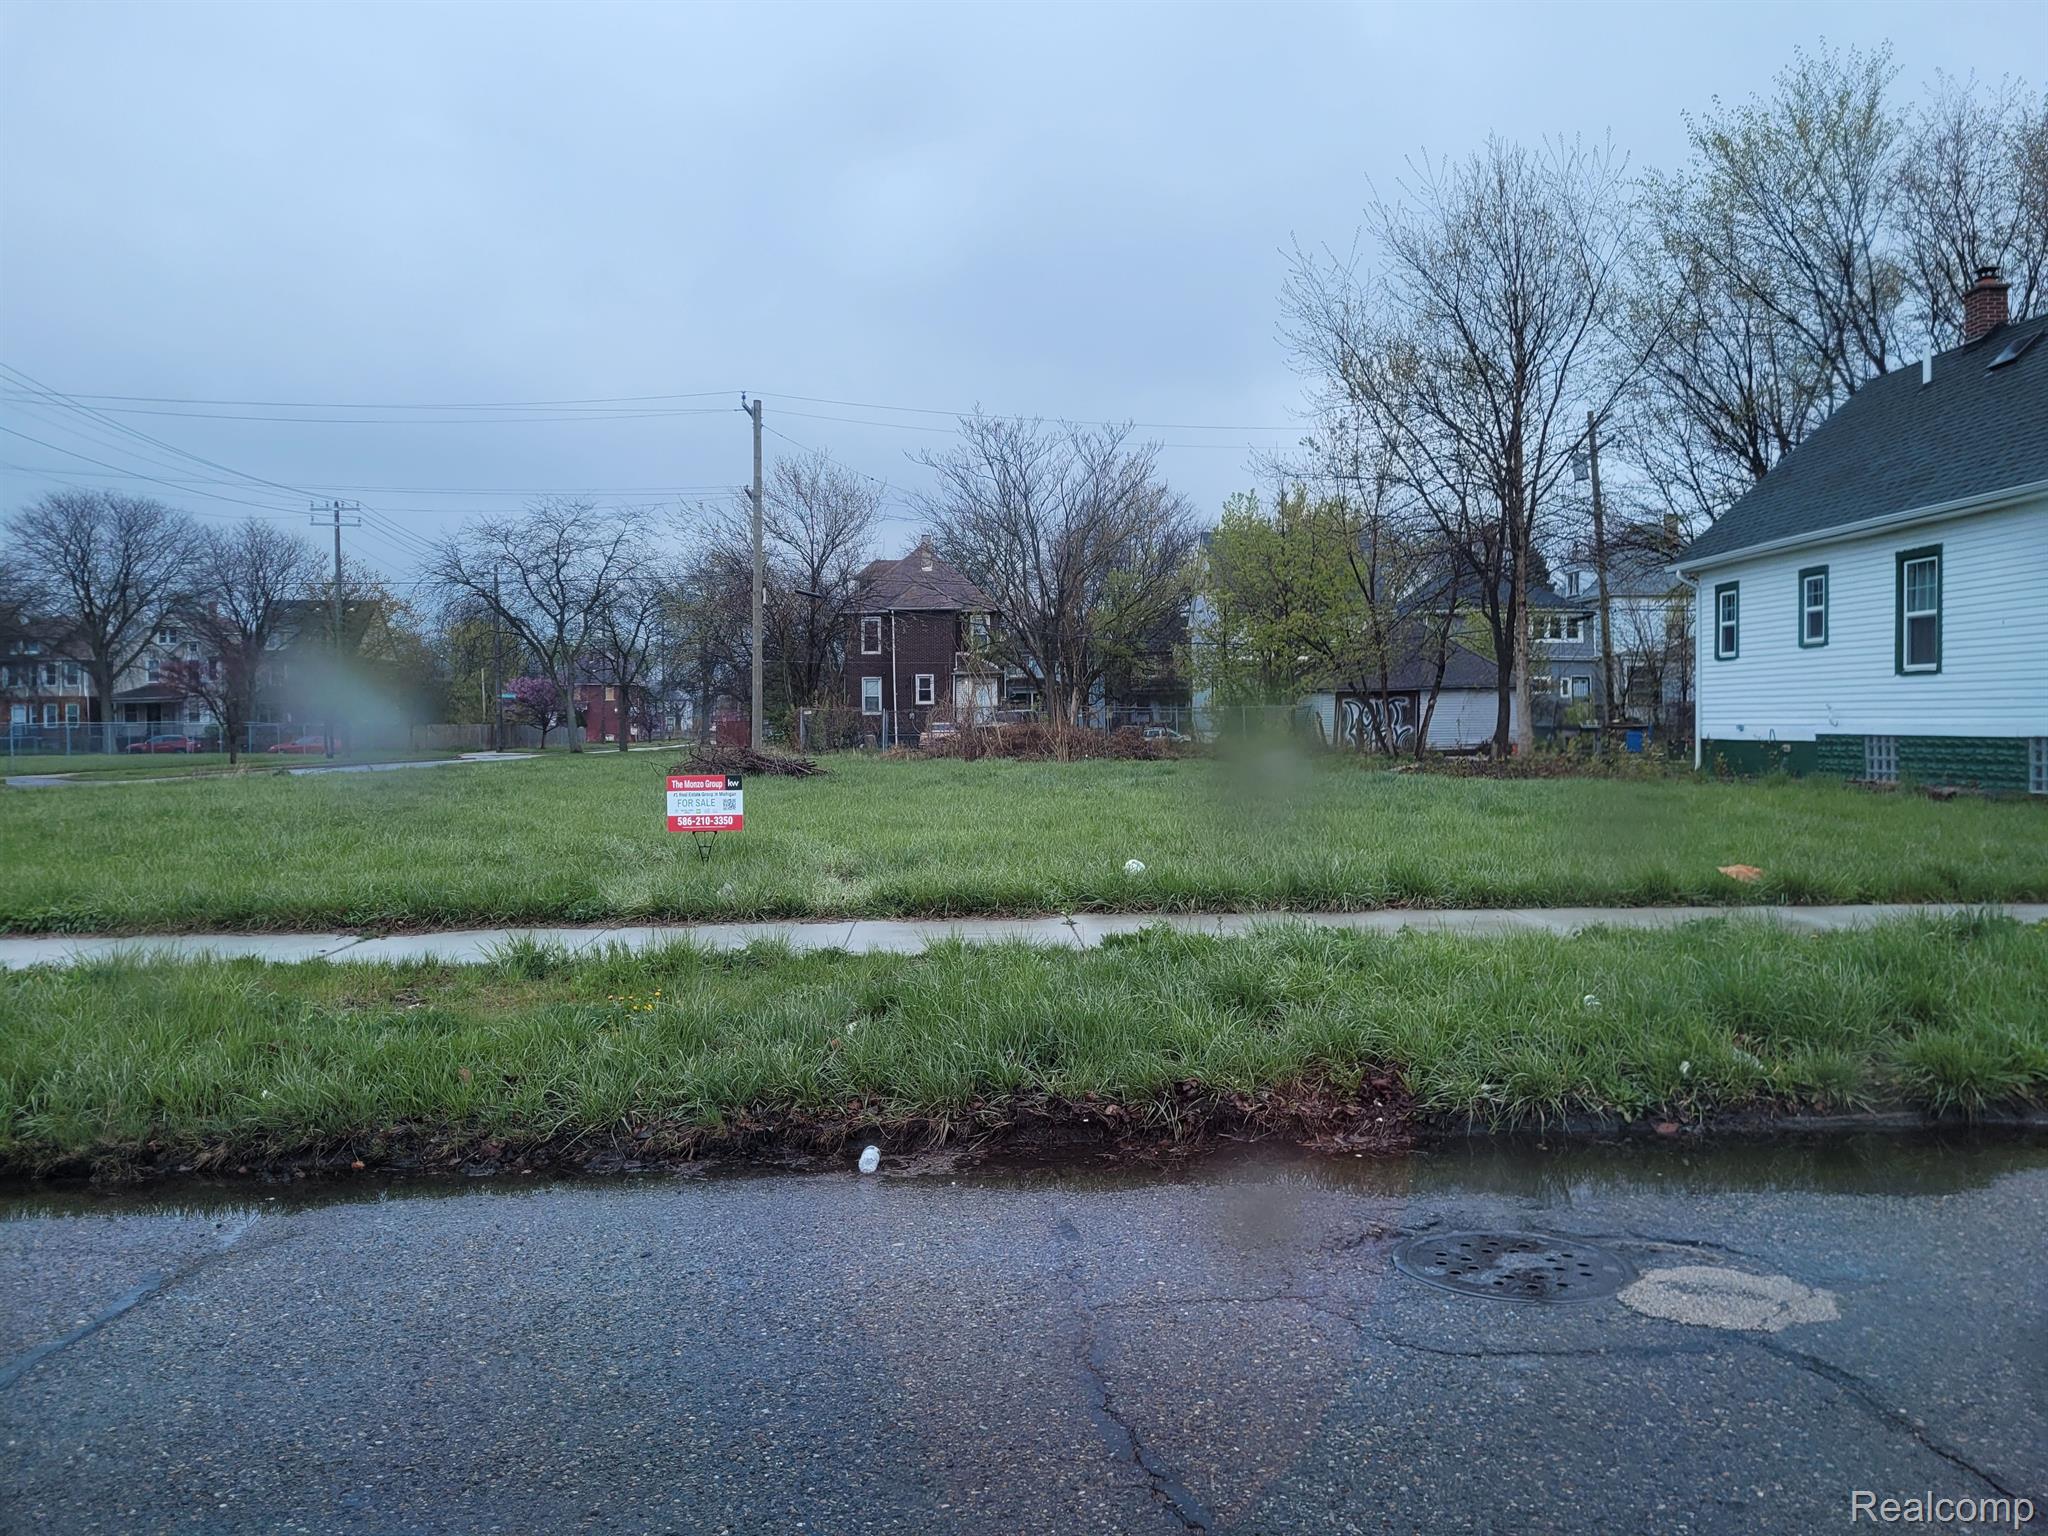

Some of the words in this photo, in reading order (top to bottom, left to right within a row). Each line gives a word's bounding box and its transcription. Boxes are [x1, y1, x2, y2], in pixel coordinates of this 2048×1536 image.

[672, 780, 683, 788] The
[684, 780, 704, 788] Monzo
[705, 780, 723, 790] Group
[727, 779, 739, 787] kw
[677, 799, 693, 807] FOR
[695, 799, 716, 807] SALE
[677, 816, 733, 826] 586-210-3350
